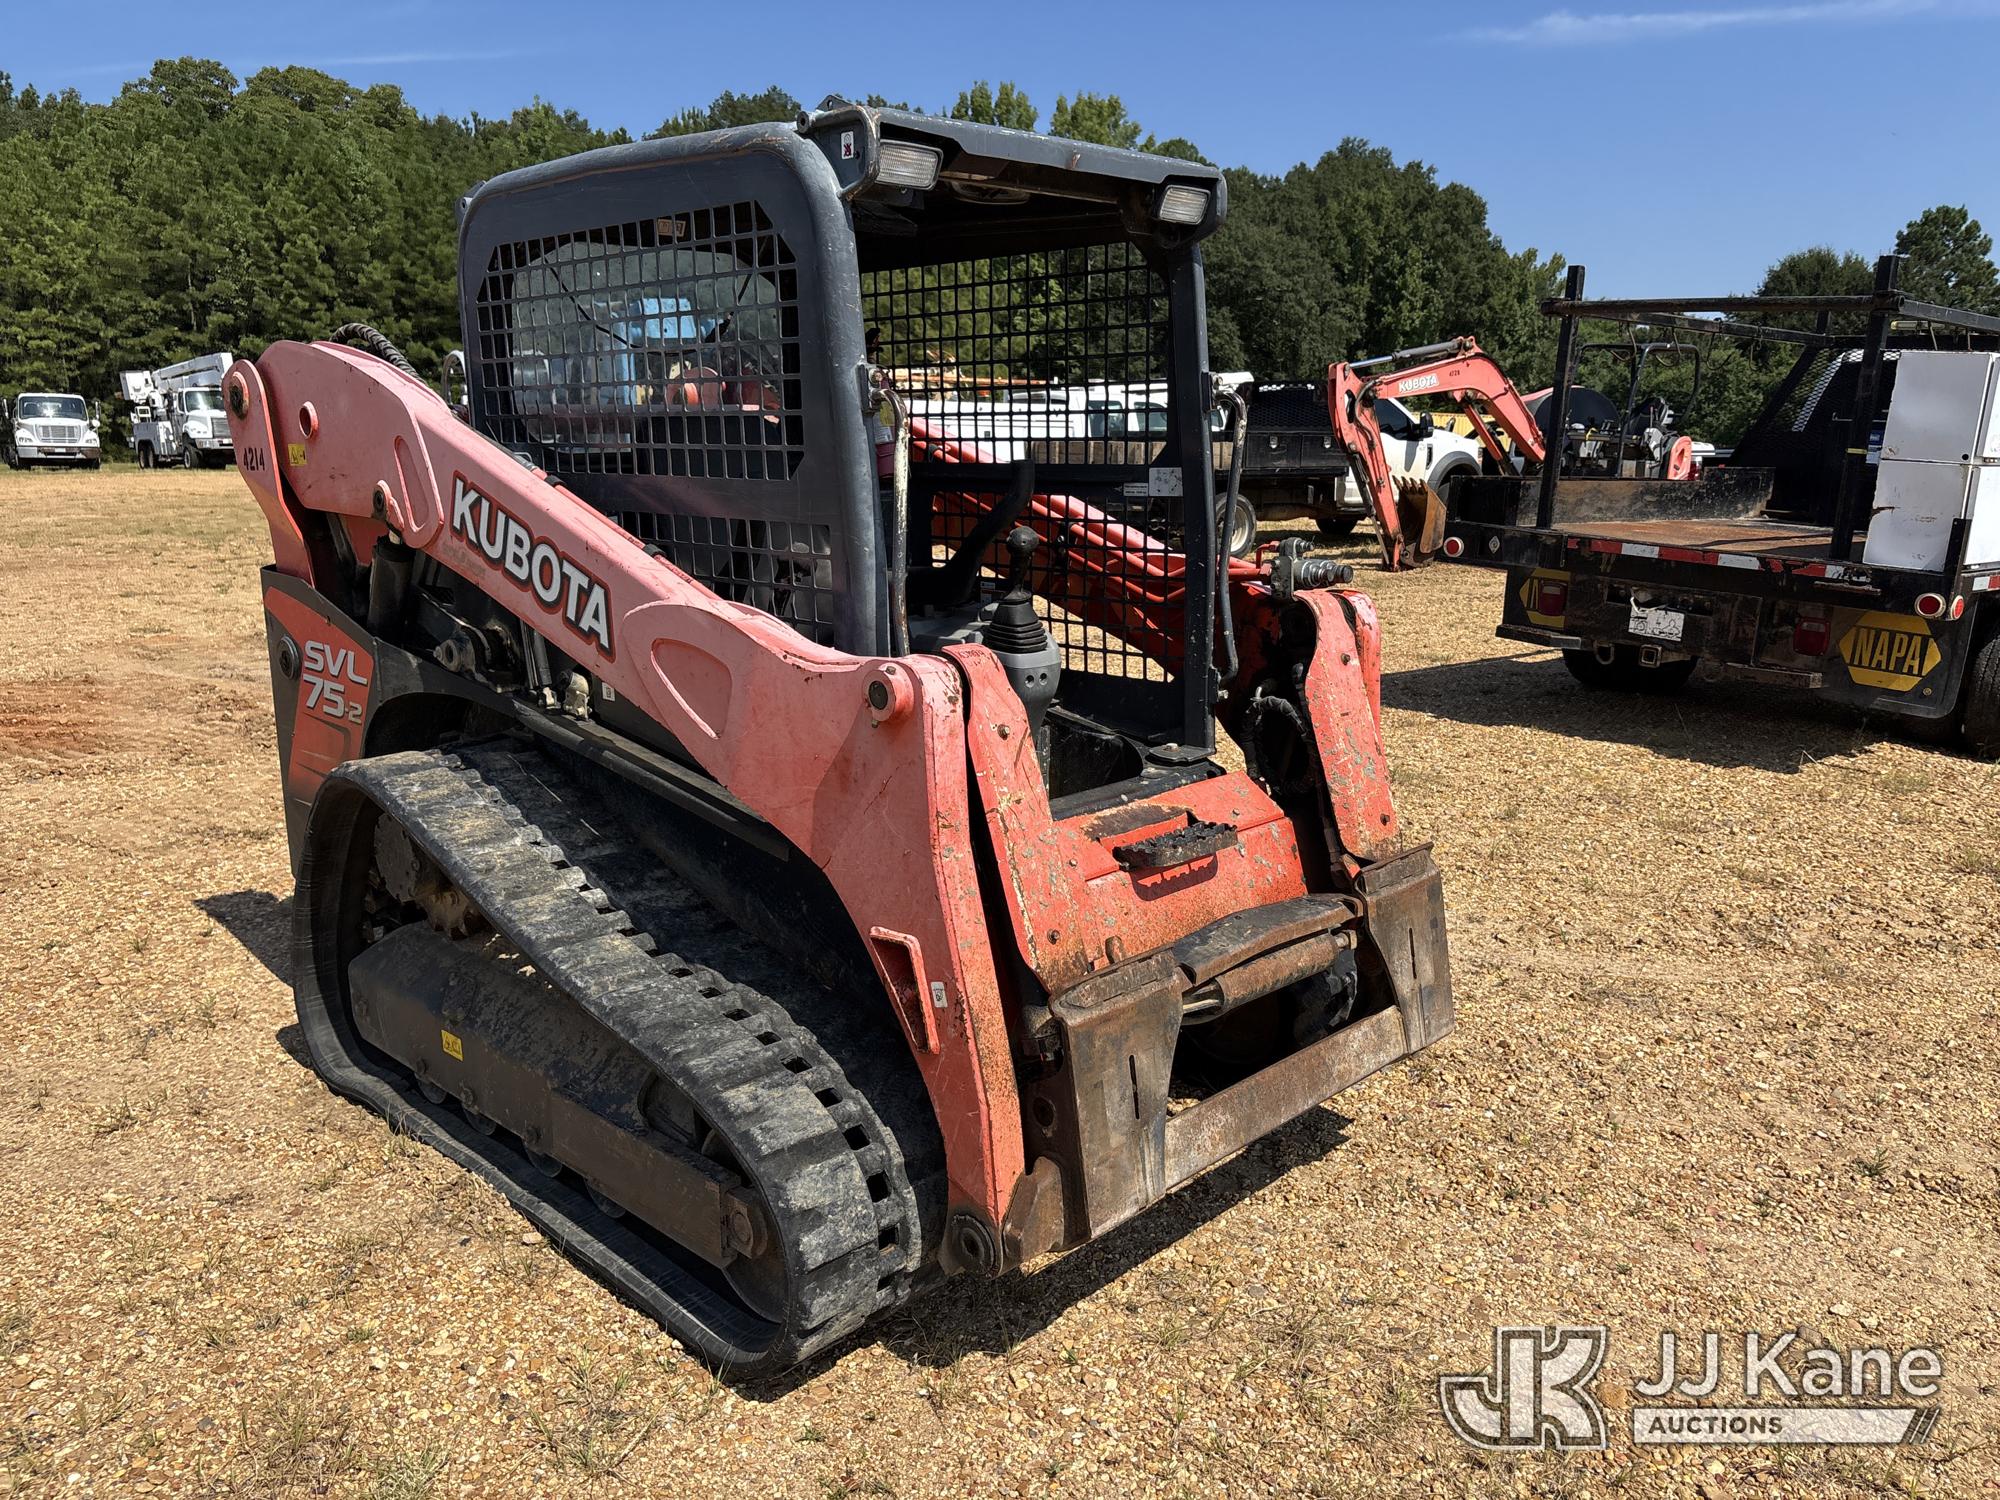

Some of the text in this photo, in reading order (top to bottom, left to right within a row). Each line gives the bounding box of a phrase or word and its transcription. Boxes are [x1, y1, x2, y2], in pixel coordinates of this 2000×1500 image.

[1398, 375, 1438, 393] KUBOTA
[243, 447, 266, 471] 4214
[452, 477, 610, 650] KUBOTA
[303, 640, 368, 687] SVL
[1852, 627, 1923, 675] NAPA
